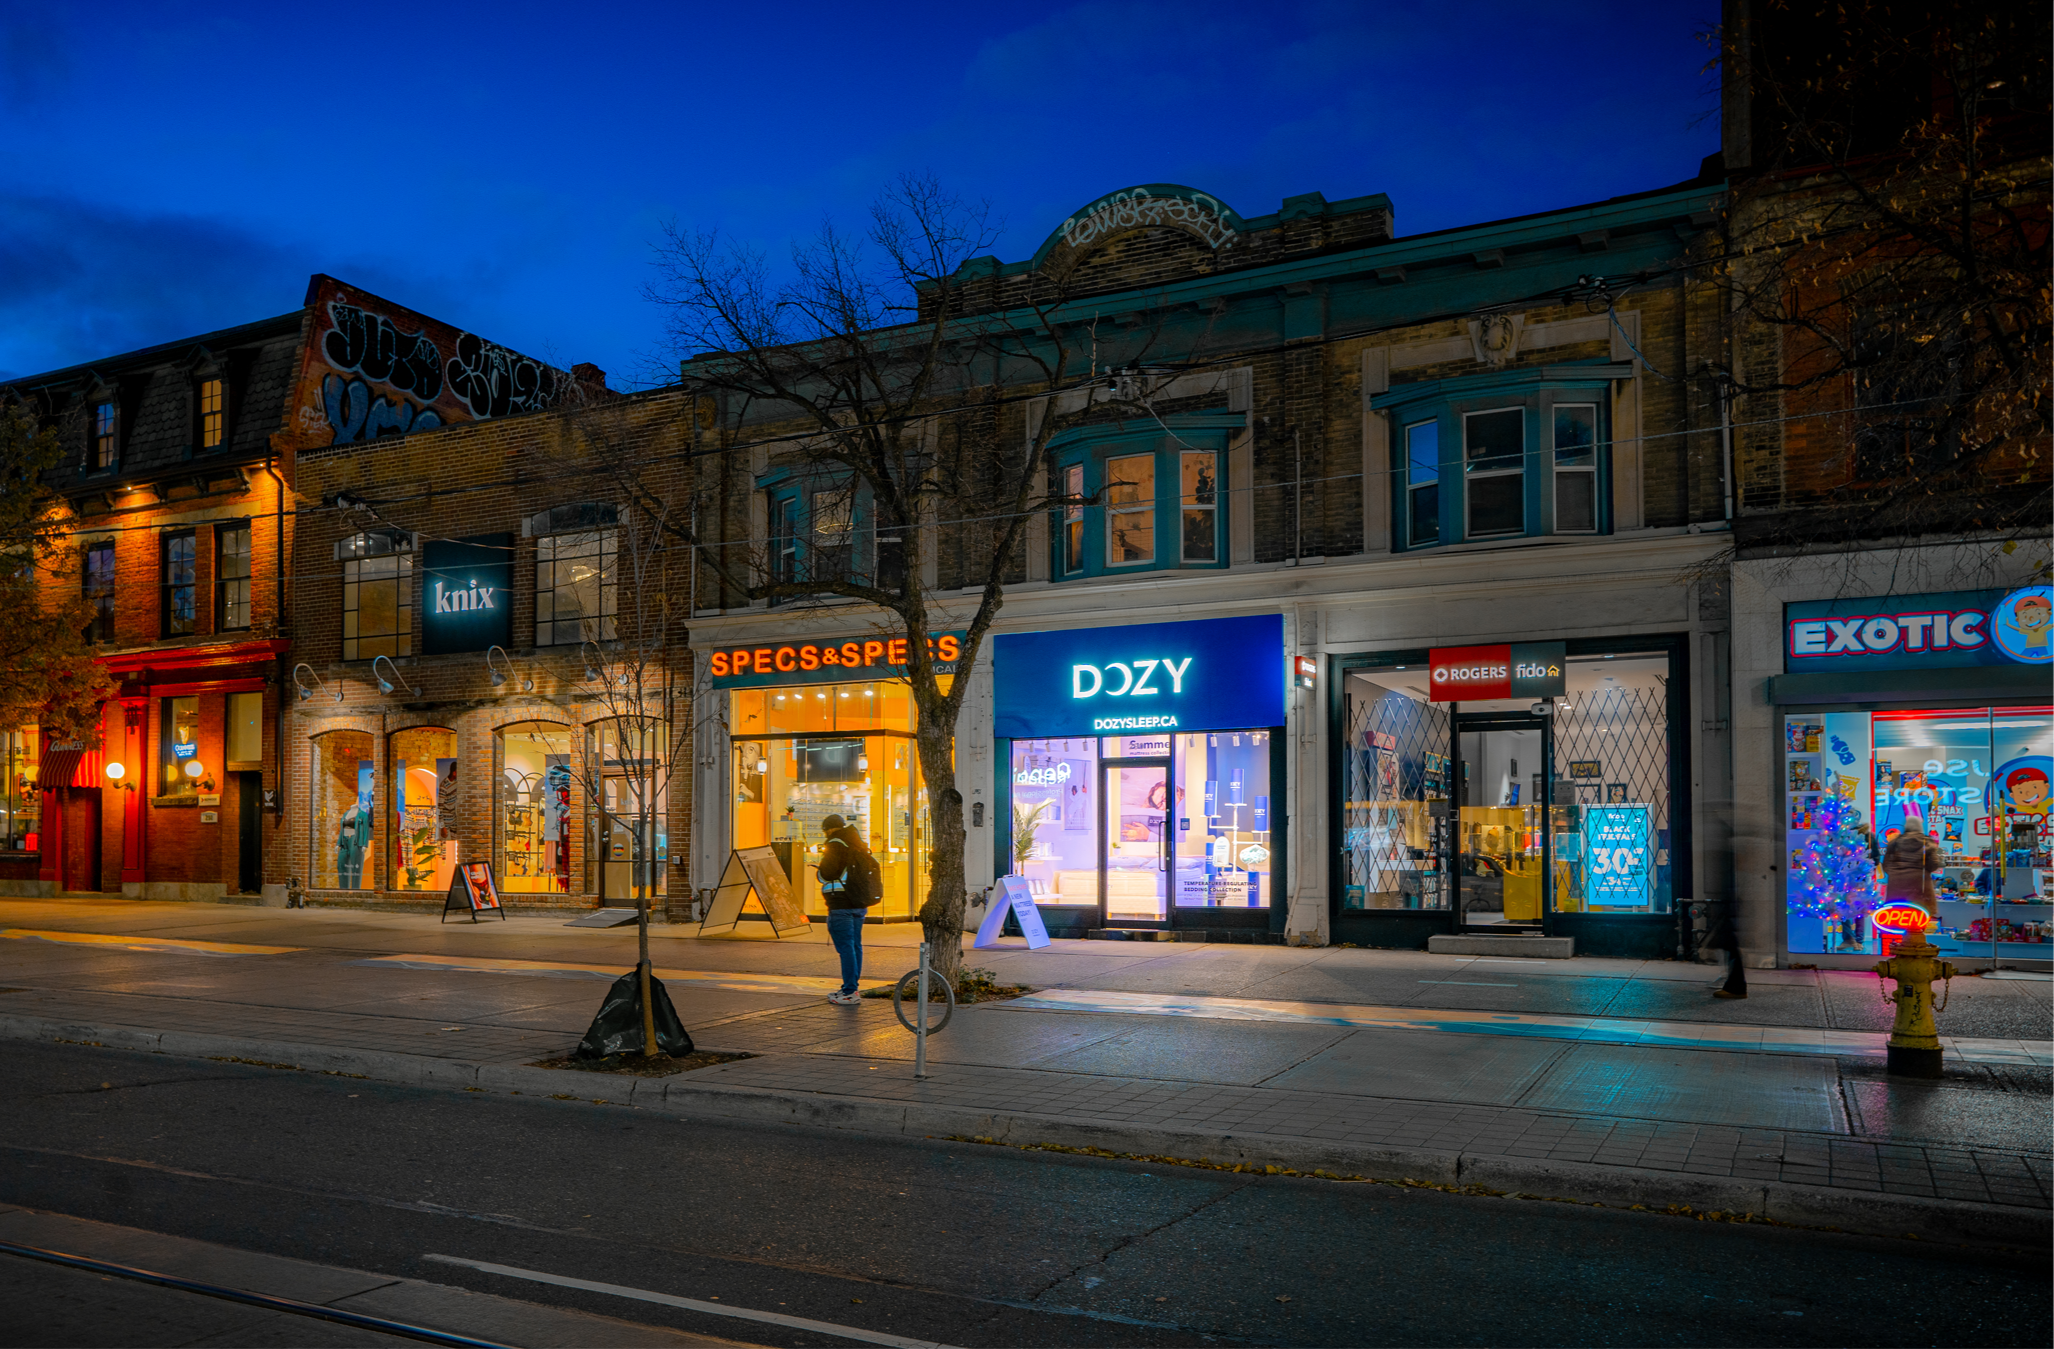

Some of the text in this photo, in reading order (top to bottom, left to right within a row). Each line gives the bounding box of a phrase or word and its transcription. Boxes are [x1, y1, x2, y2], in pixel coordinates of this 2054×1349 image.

[435, 579, 494, 613] knix
[1791, 610, 1988, 656] EXOTIC
[711, 635, 960, 676] SPECS&SPES
[1073, 658, 1192, 698] DOZY
[1450, 665, 1507, 680] ROGERS
[1516, 663, 1546, 678] fido
[1094, 715, 1178, 730] DOZYSLEEP.CA
[1937, 806, 1963, 815] SNAX
[1876, 910, 1925, 926] OPEN
